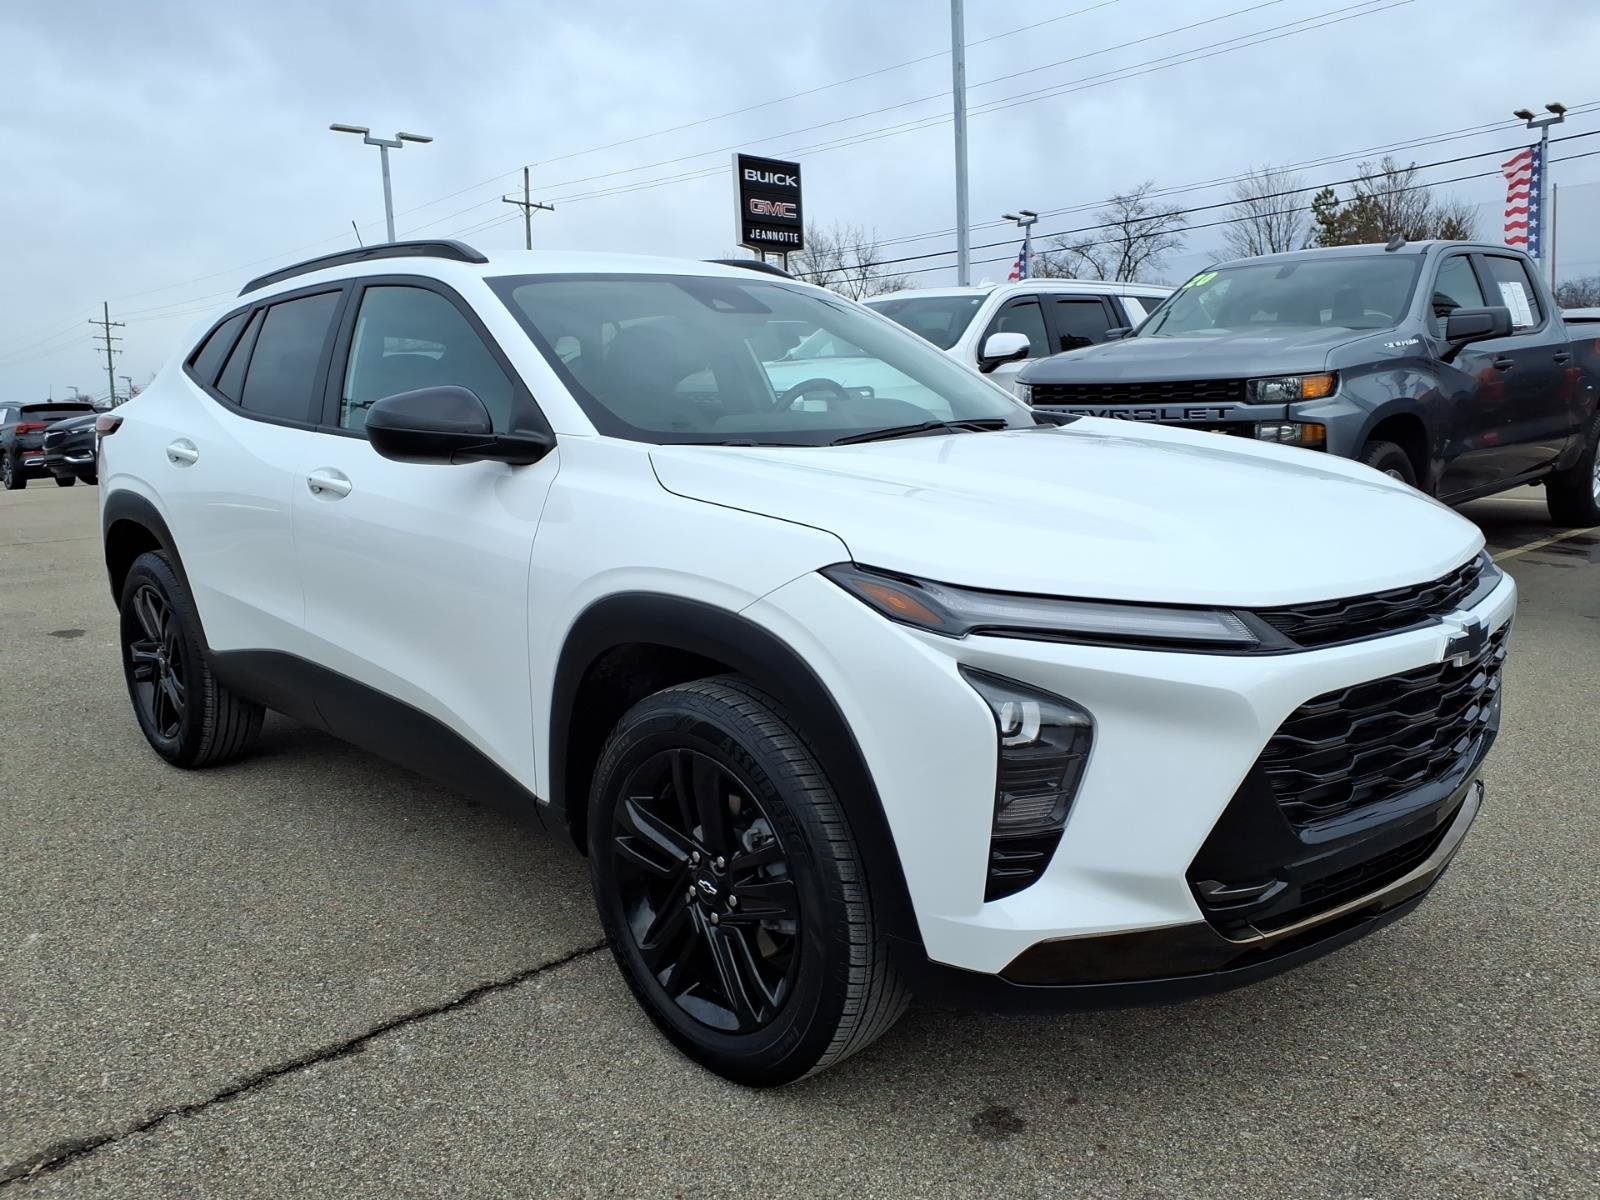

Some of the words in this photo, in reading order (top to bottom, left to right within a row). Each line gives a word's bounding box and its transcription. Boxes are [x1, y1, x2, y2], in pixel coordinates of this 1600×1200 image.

[744, 168, 798, 187] BUICK
[750, 198, 797, 218] GMC
[750, 229, 799, 243] JEANNOTTE
[1036, 407, 1235, 420] EVROLET
